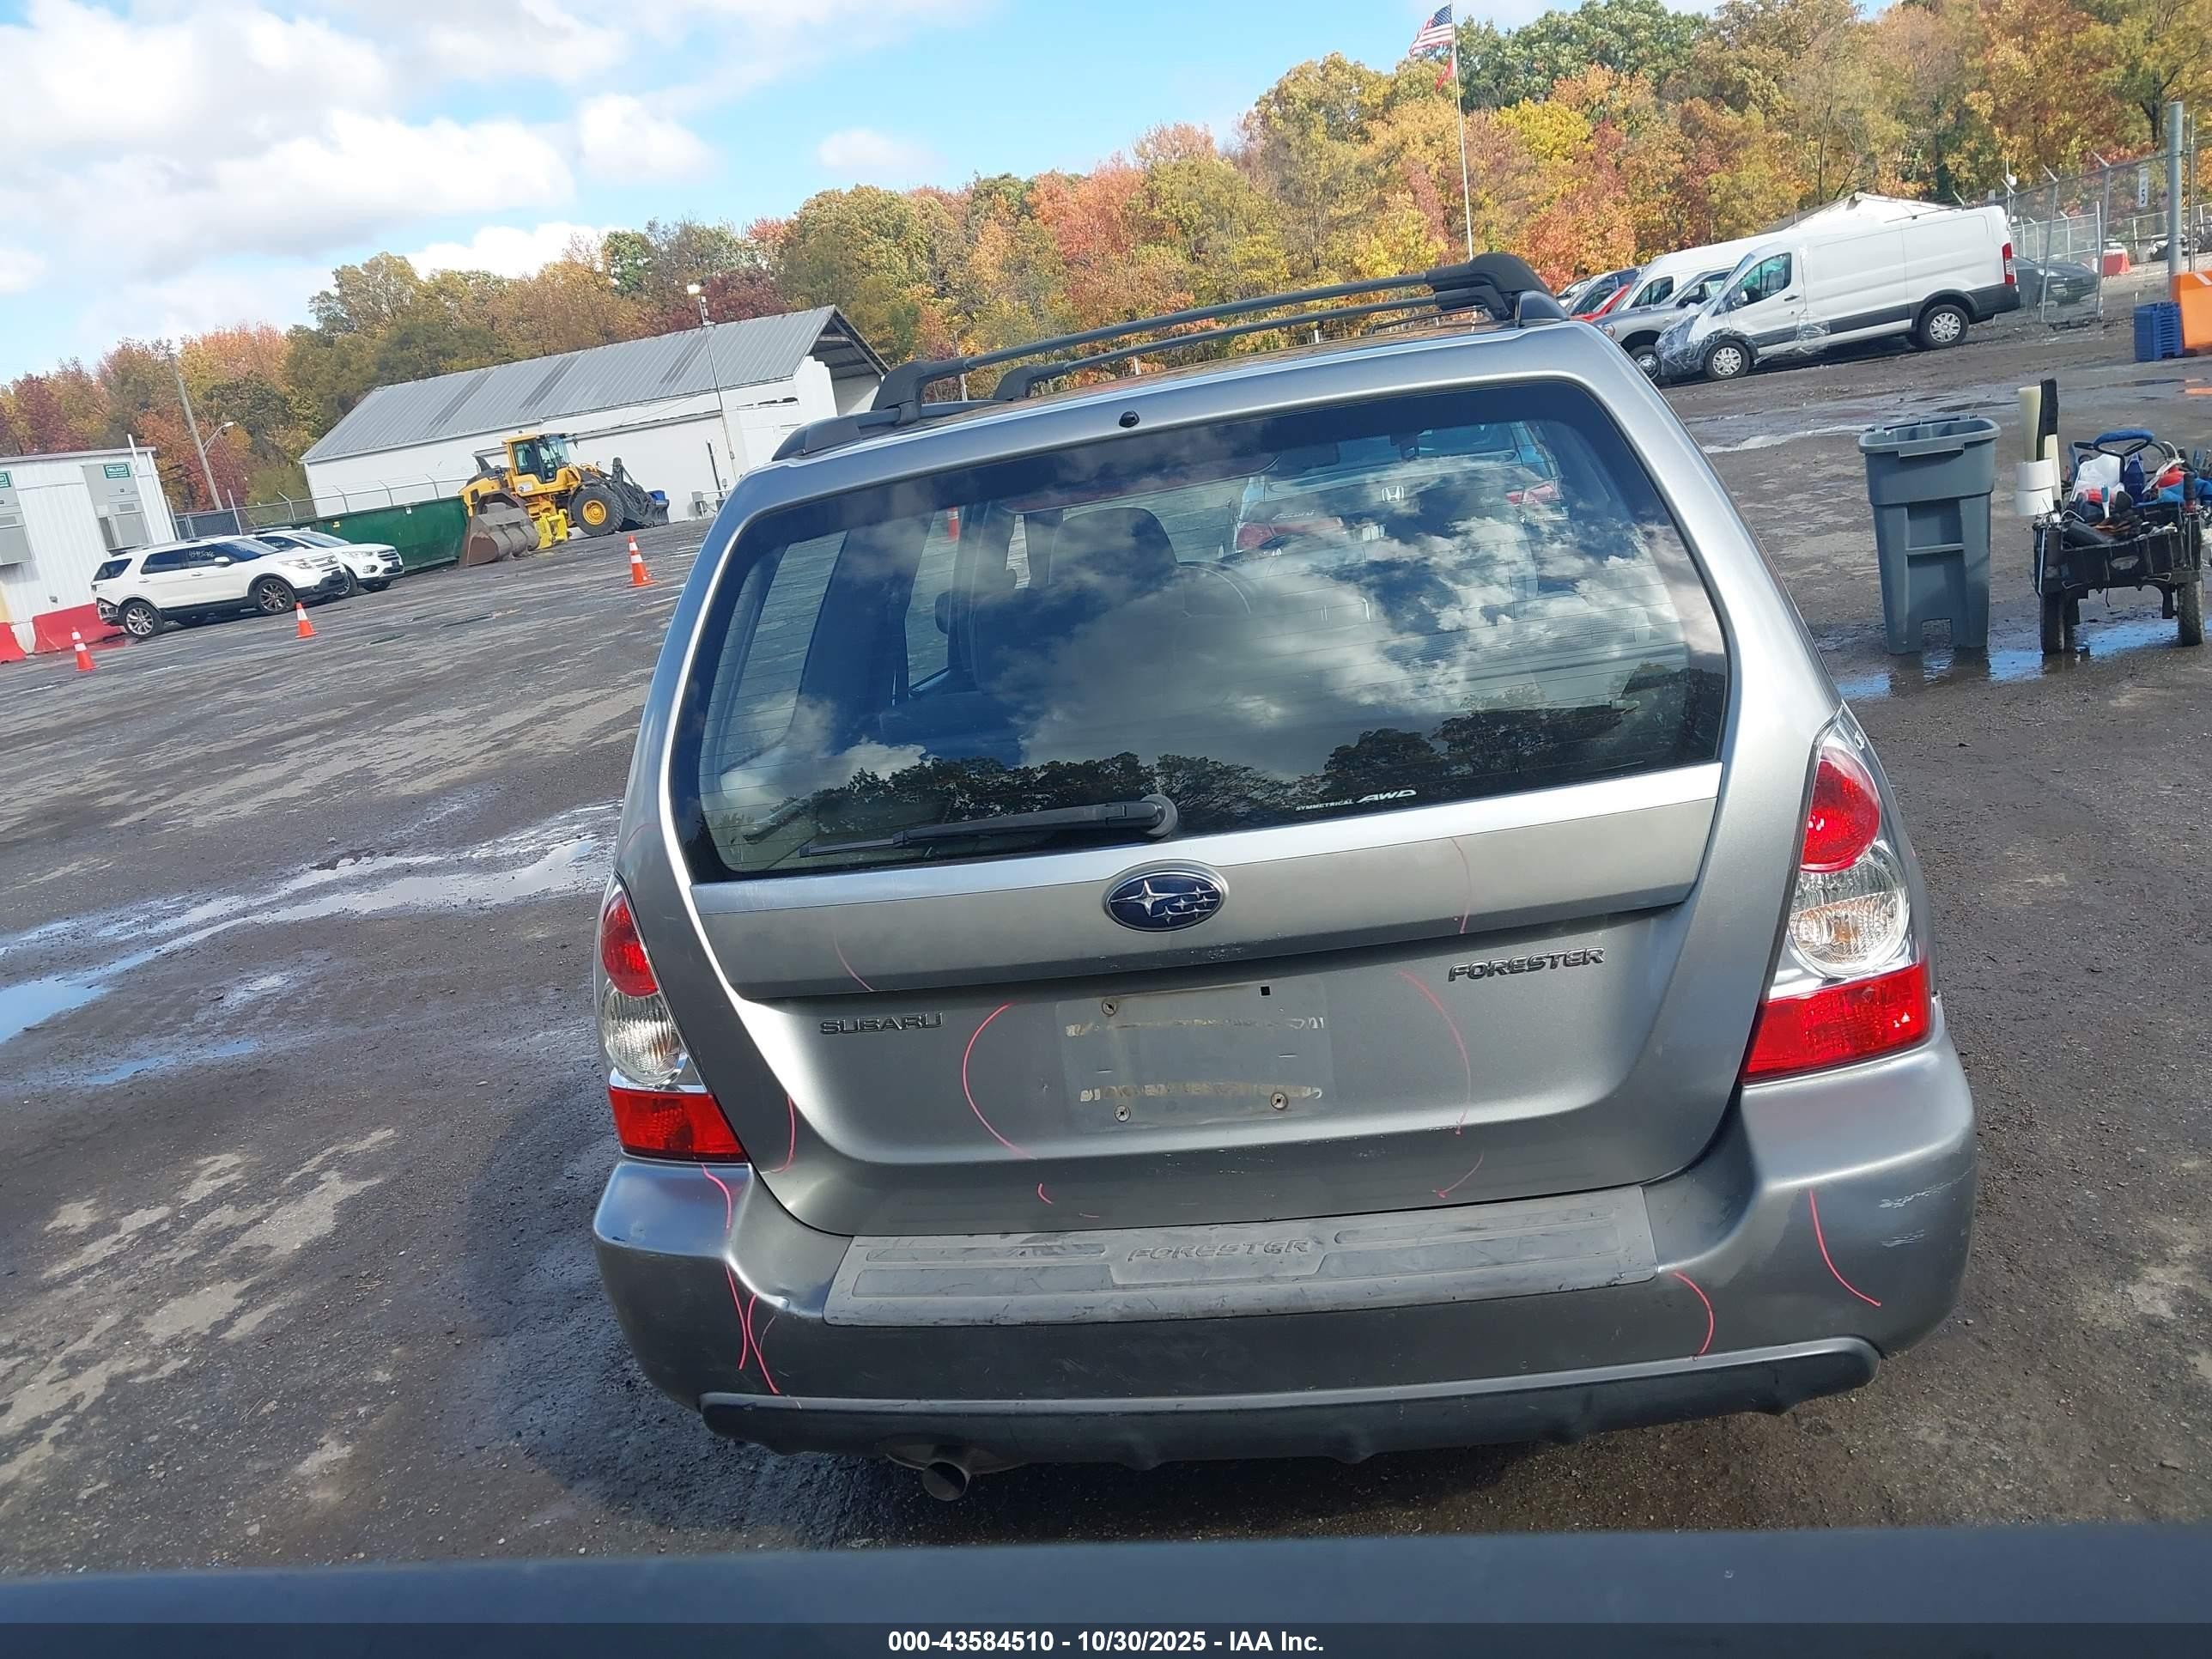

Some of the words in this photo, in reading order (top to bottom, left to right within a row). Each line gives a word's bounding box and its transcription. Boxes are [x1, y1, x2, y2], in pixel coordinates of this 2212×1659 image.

[1295, 799, 1354, 811] SYMMETRICAL
[1356, 789, 1417, 804] AWD
[1449, 947, 1606, 982] FORESTER
[820, 1012, 943, 1035] SUBARU
[1127, 1239, 1310, 1262] FORESTER
